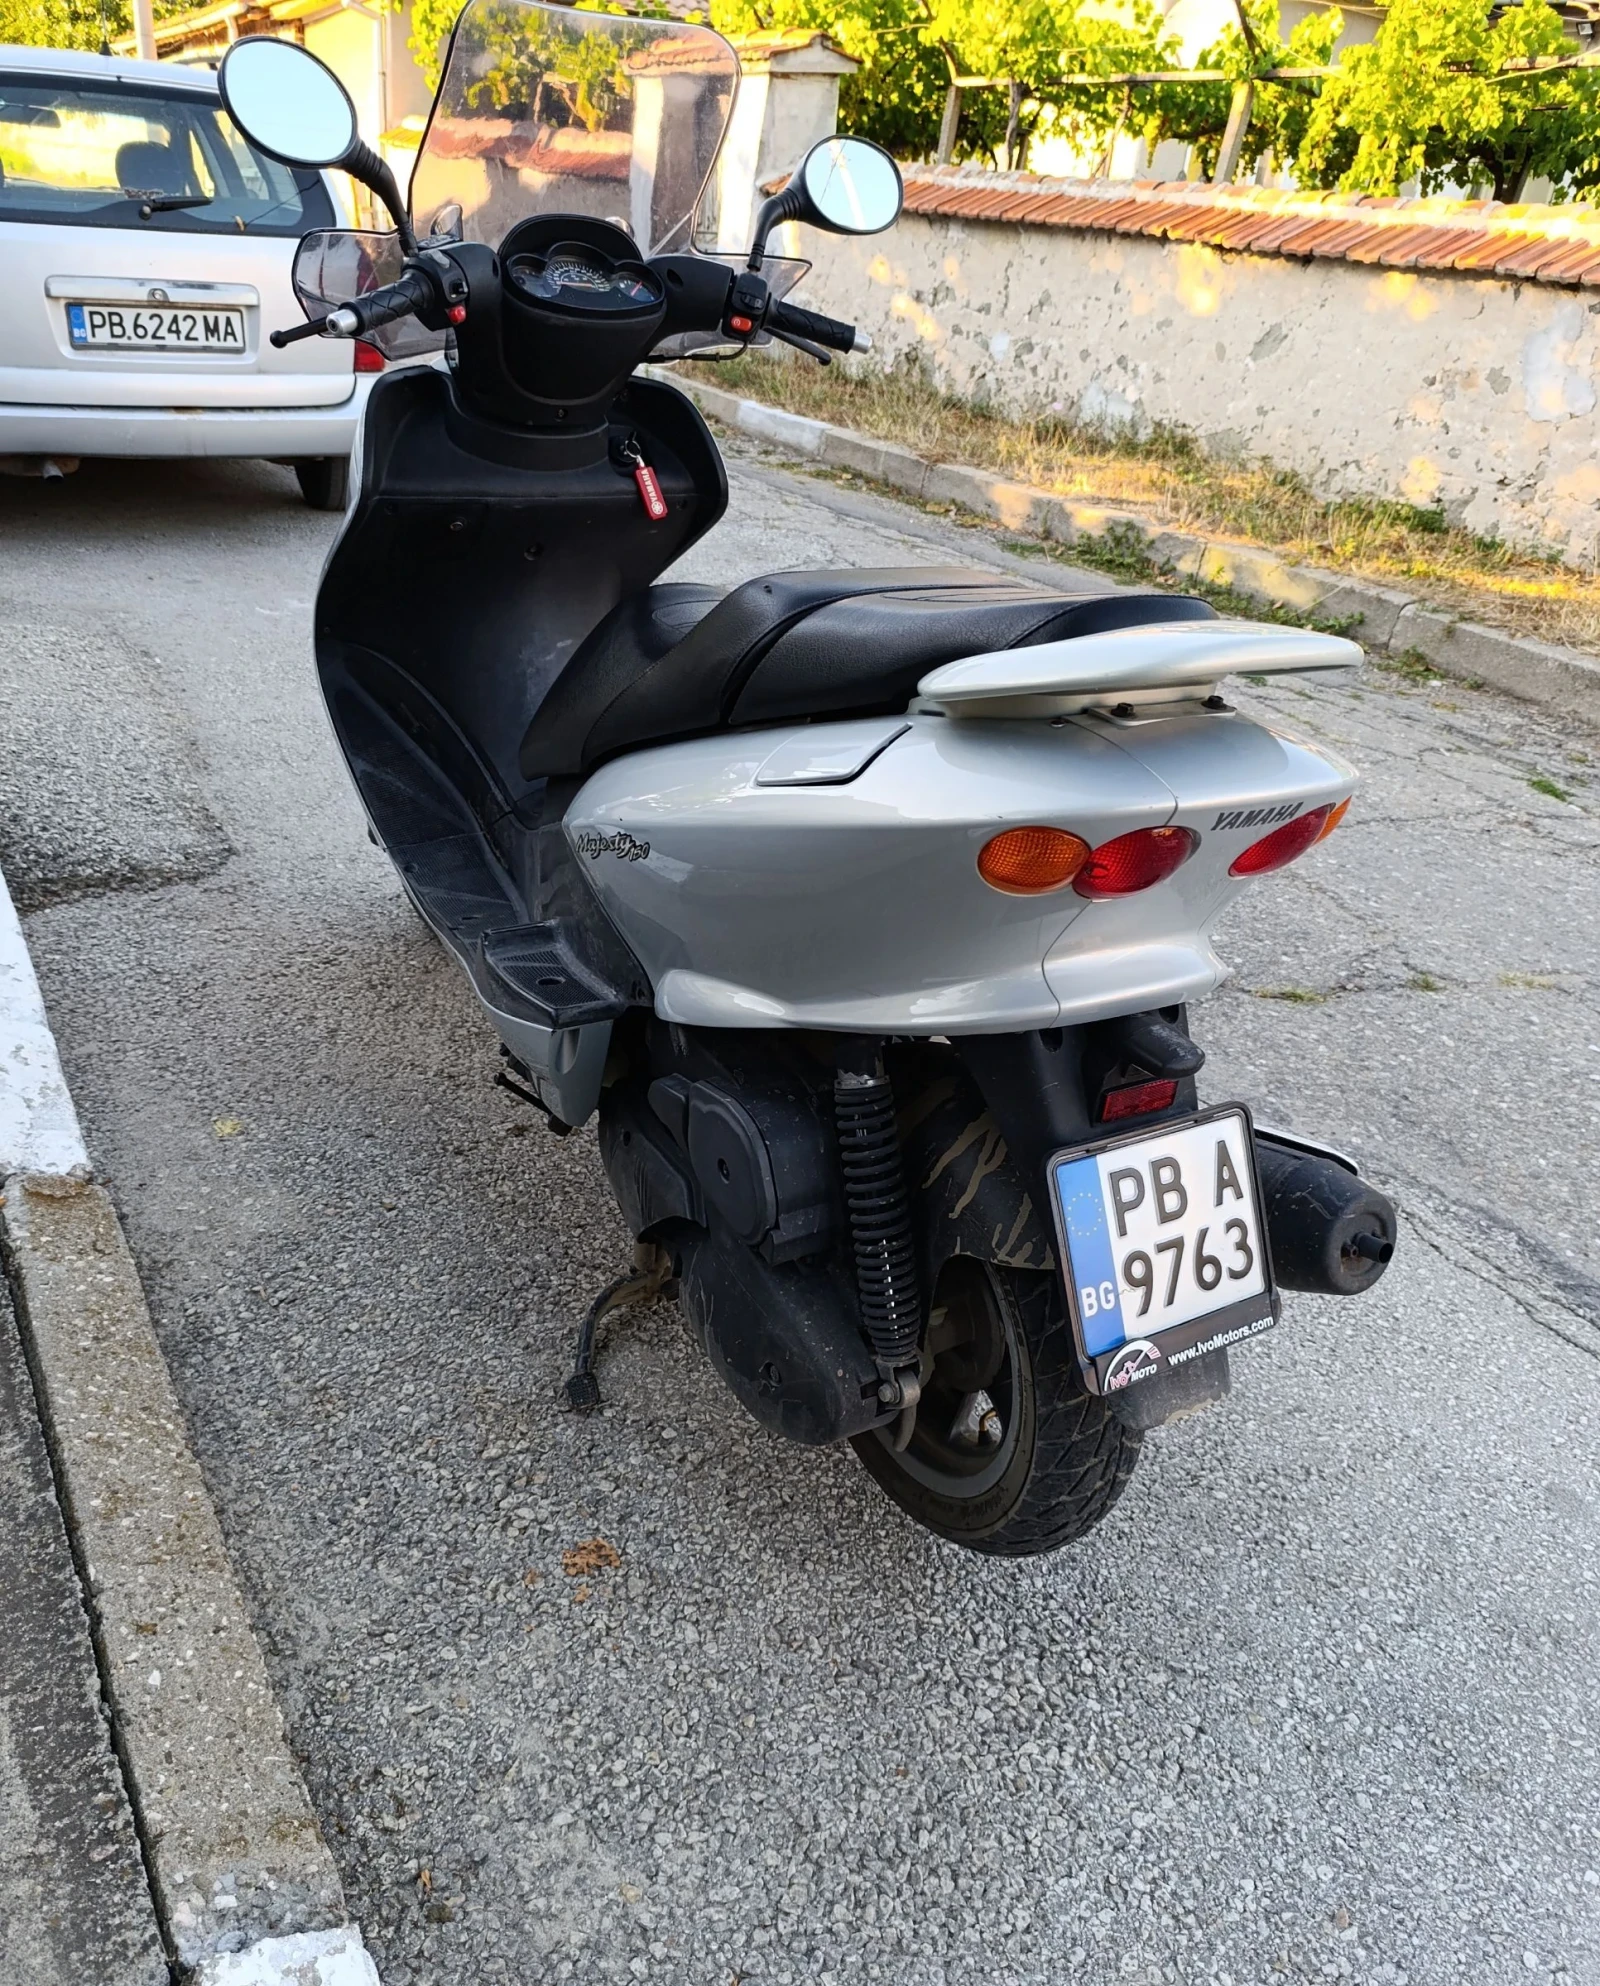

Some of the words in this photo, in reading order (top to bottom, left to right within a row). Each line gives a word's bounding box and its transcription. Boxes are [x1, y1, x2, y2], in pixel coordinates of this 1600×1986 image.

[641, 469, 659, 502] YAMAHA
[1210, 801, 1304, 831] YAMAHA
[576, 831, 635, 860] Majesty
[1109, 1155, 1188, 1237] PB
[1214, 1139, 1244, 1207] A
[1123, 1217, 1254, 1317] 9763
[1080, 1281, 1115, 1317] BG
[1168, 1315, 1274, 1366] www.IvoMotors.com
[1130, 1363, 1158, 1382] MOTO
